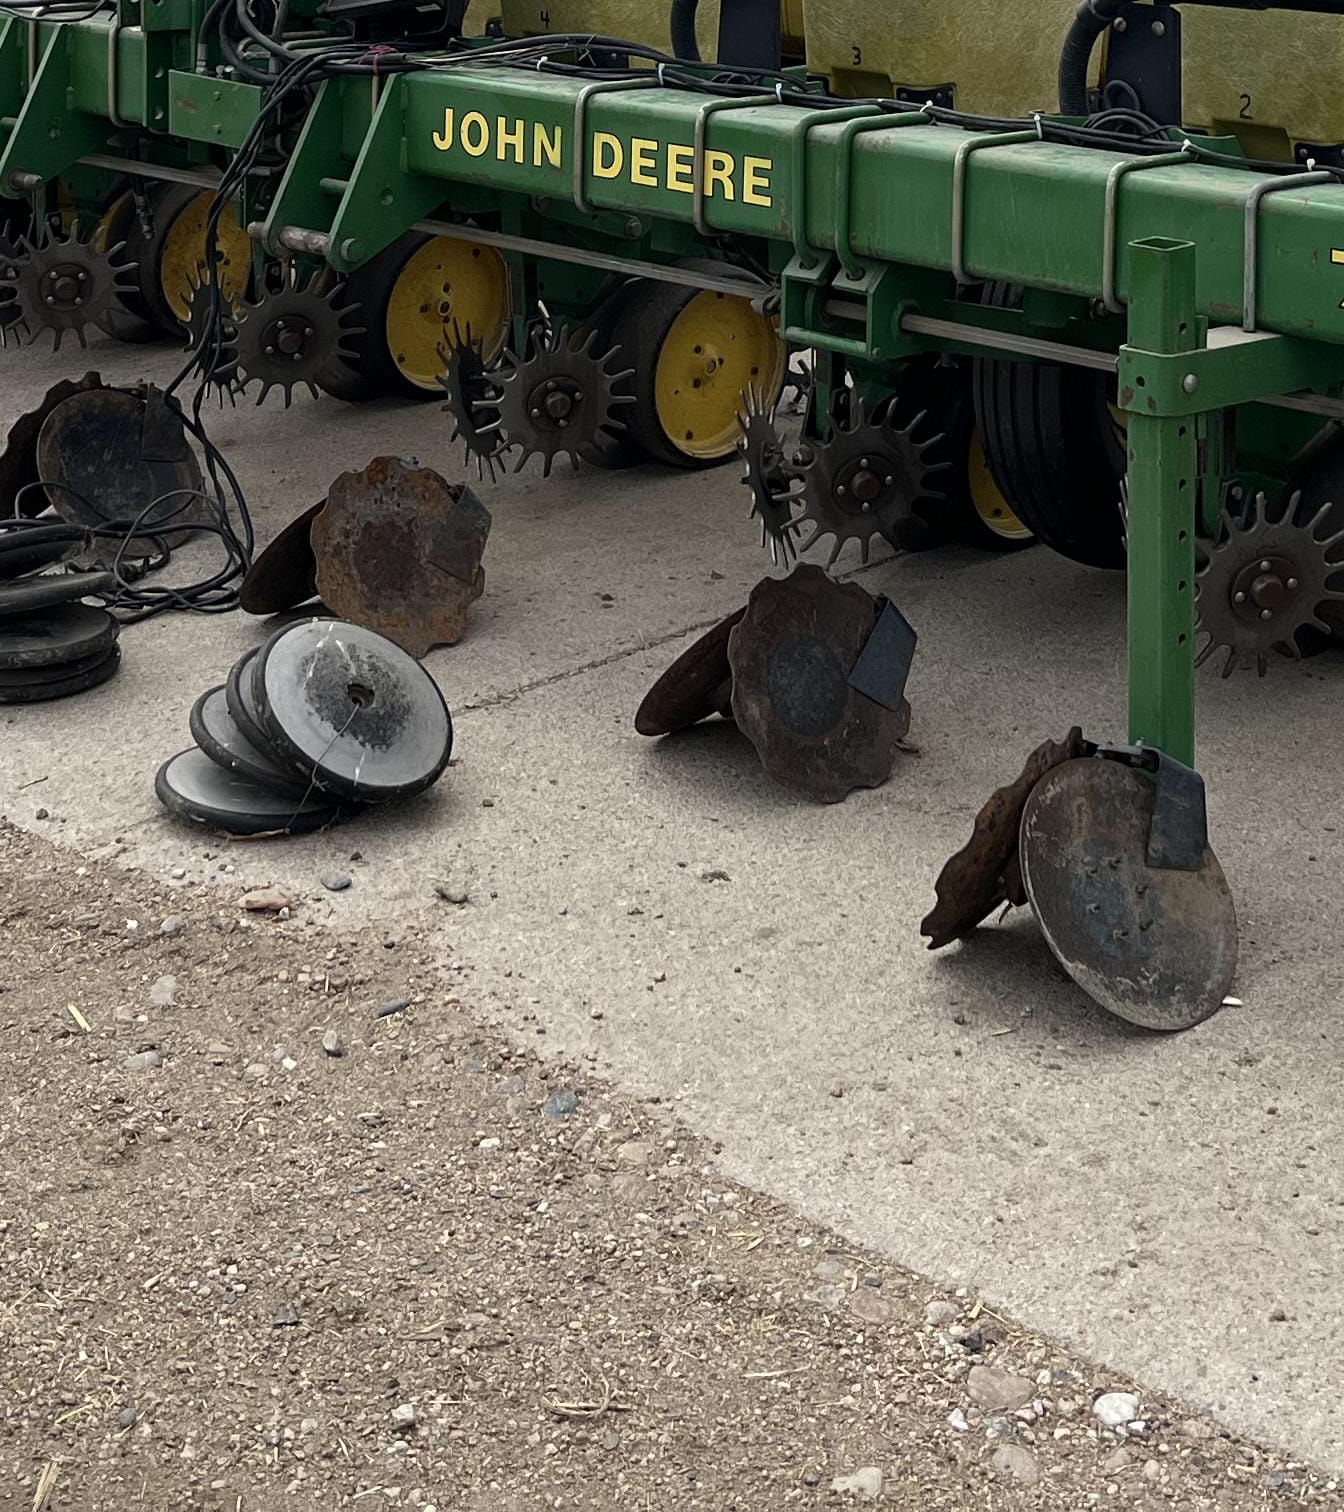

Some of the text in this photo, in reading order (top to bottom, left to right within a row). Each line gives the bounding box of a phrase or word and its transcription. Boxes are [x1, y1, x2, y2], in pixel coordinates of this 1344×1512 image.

[540, 9, 551, 30] 4
[851, 46, 862, 66] 3
[1239, 93, 1254, 120] 2
[431, 107, 774, 208] JOHN DEERE
